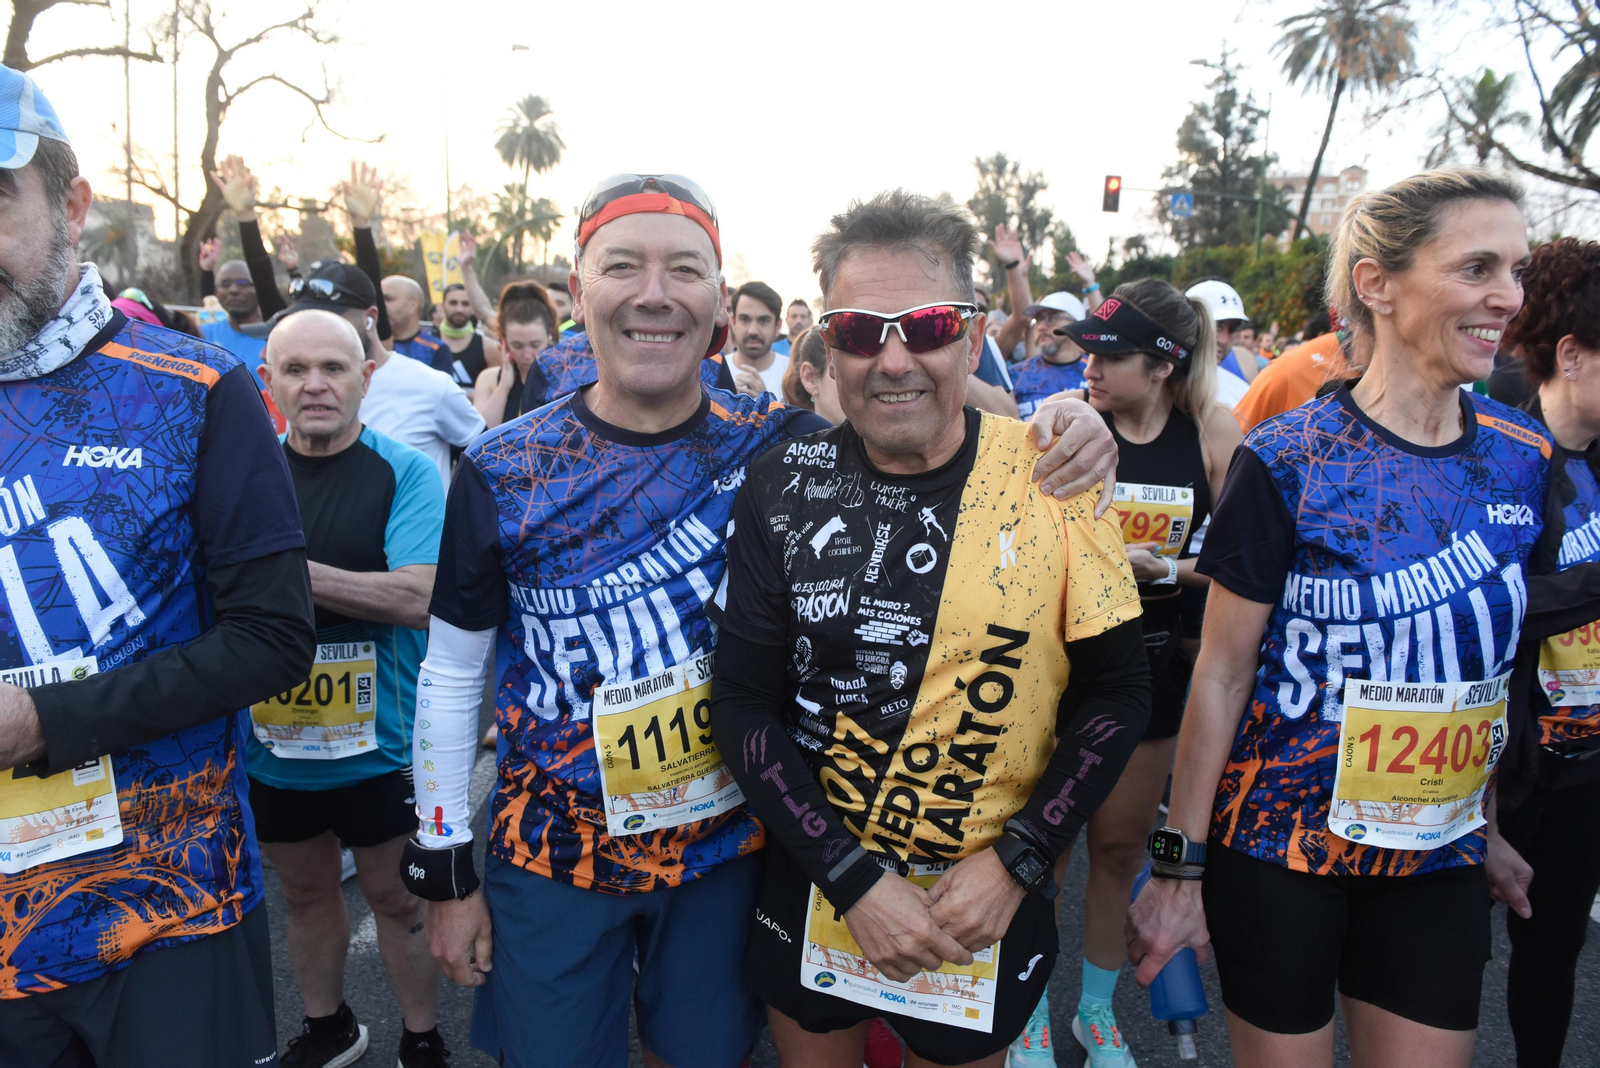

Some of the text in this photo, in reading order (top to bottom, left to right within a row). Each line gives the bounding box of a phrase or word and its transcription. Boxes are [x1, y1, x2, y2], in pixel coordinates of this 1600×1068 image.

[62, 445, 142, 469] HOKA
[785, 442, 837, 460] AHORA
[710, 466, 749, 498] HOK
[1142, 486, 1176, 502] SEVILLA
[1486, 504, 1534, 525] HOKA
[864, 521, 892, 584] RENDIRSE
[507, 580, 576, 615] MEDIO
[583, 513, 720, 608] MARATÓN
[1283, 529, 1498, 621] MEDIO MARATÓN
[791, 582, 801, 593] NO
[860, 596, 871, 606] EL
[873, 599, 901, 611] MURO
[857, 607, 922, 627] MIS COJONES
[321, 643, 358, 660] SEVILLA
[1277, 562, 1527, 721] SEVILLA
[855, 662, 889, 675] CORRE
[864, 655, 890, 665] SUEGRA
[264, 671, 351, 707] 201
[603, 686, 632, 706] MEDIO
[633, 671, 675, 701] MARATÓN
[830, 676, 867, 691] TIRADA
[1360, 678, 1501, 706] MEDIO MARATÓN SEVILLA
[835, 693, 869, 706] LARGA
[880, 698, 909, 715] RETO
[867, 623, 1029, 863] MEDIO MARATÓN
[1359, 720, 1491, 775] 12403
[660, 747, 716, 773] SALVATIERRA
[1346, 742, 1355, 768] CAJÓN
[647, 772, 695, 792] SALVATIERRA
[1042, 747, 1103, 826] TLG
[1420, 777, 1444, 786] Cristi
[689, 799, 716, 814] HOKA
[760, 761, 827, 838] TLG
[1391, 795, 1430, 803] Alconchel
[1416, 831, 1441, 840] HOKA
[880, 990, 907, 1005] HOKA
